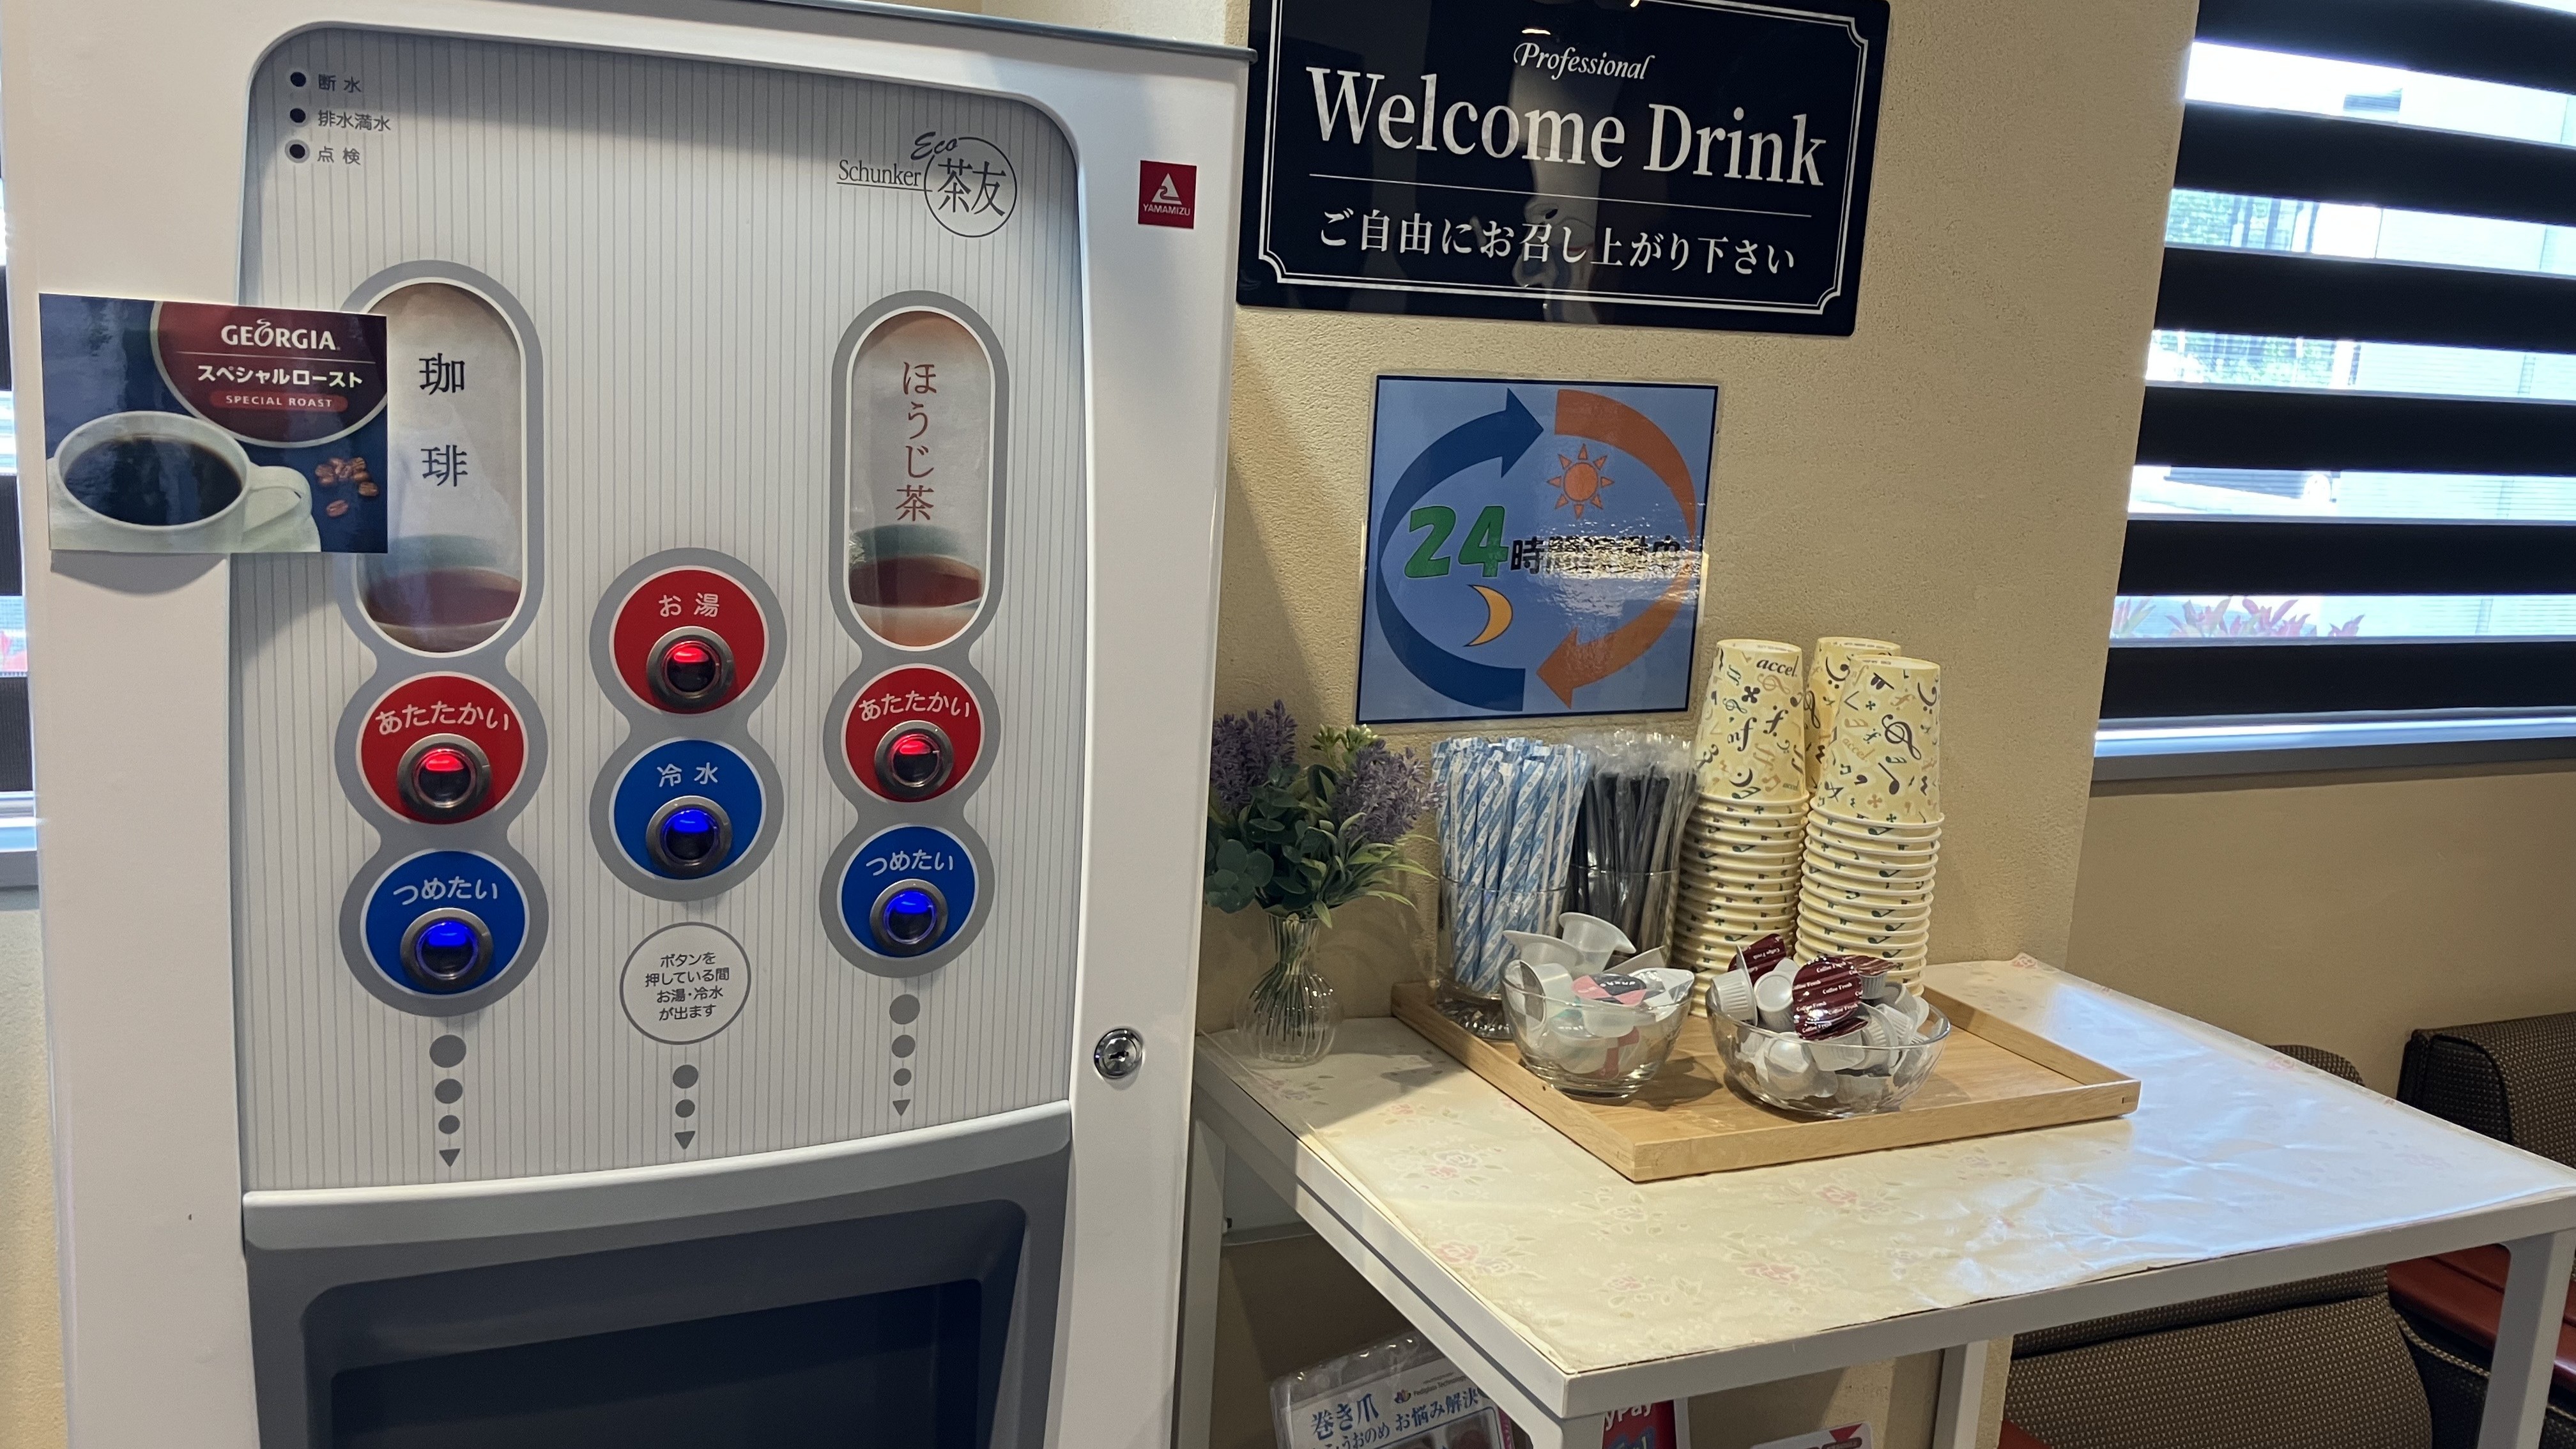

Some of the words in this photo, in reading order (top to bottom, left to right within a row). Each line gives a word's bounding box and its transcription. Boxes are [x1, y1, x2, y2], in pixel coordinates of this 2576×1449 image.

[1514, 42, 1655, 80] Professional
[318, 109, 391, 132] 排水満水
[1305, 66, 1626, 169] Welcome
[1643, 103, 1827, 187] Drink
[317, 146, 361, 165] 点検
[910, 131, 958, 160] Eco
[838, 159, 922, 187] Schunker
[937, 158, 1007, 217] 茶友
[1142, 203, 1191, 217] YAMAMIZU
[1320, 207, 1795, 275] ご自由にお召し上がり下さい
[221, 318, 336, 351] GEORGIA
[197, 364, 363, 388] スペシャルロースト
[226, 395, 282, 406] SPECIAL
[289, 397, 332, 408] ROAST
[896, 362, 937, 522] ほうじ茶
[658, 592, 720, 617] お湯
[375, 701, 510, 735] あたたかい
[859, 690, 970, 722] あたたかい
[657, 762, 719, 788] 冷水
[866, 849, 954, 877] つめたい
[393, 876, 498, 905] つめたい
[660, 952, 716, 969] ボタンを
[645, 967, 730, 988] 押している間
[659, 1004, 717, 1022] が出ます
[1311, 1393, 1379, 1441] 巻き爪
[1395, 1387, 1479, 1432] お悩み解決
